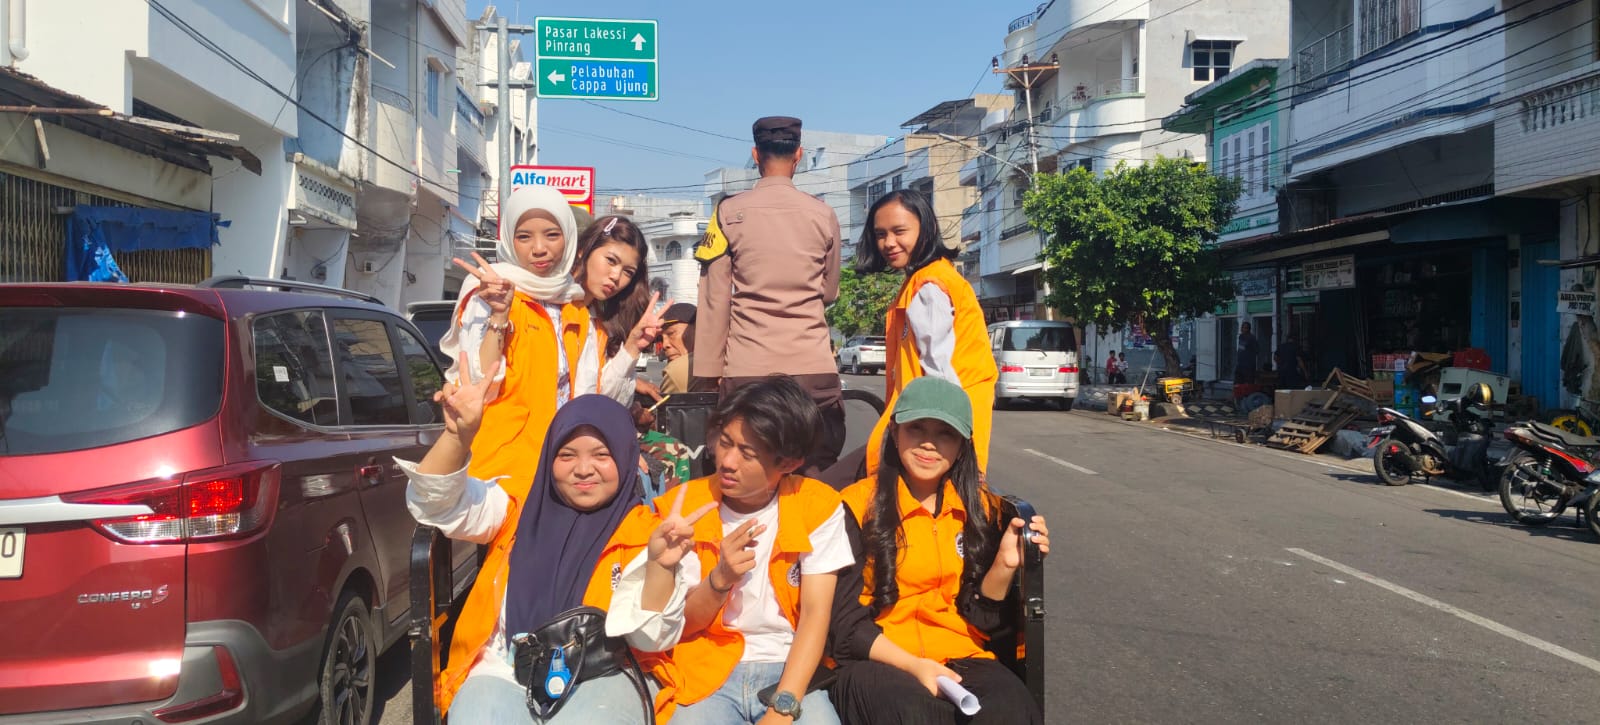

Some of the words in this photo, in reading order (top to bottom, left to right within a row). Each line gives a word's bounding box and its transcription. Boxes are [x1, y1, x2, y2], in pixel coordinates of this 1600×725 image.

[545, 25, 578, 38] Pasar
[584, 26, 626, 40] Lakessi
[545, 39, 591, 56] Pinrang
[571, 64, 634, 79] Pelabuhan
[571, 78, 607, 93] Cappa
[615, 79, 648, 95] Ujung
[512, 171, 586, 187] Alfamart
[78, 590, 153, 604] CONFERO
[151, 583, 168, 604] S
